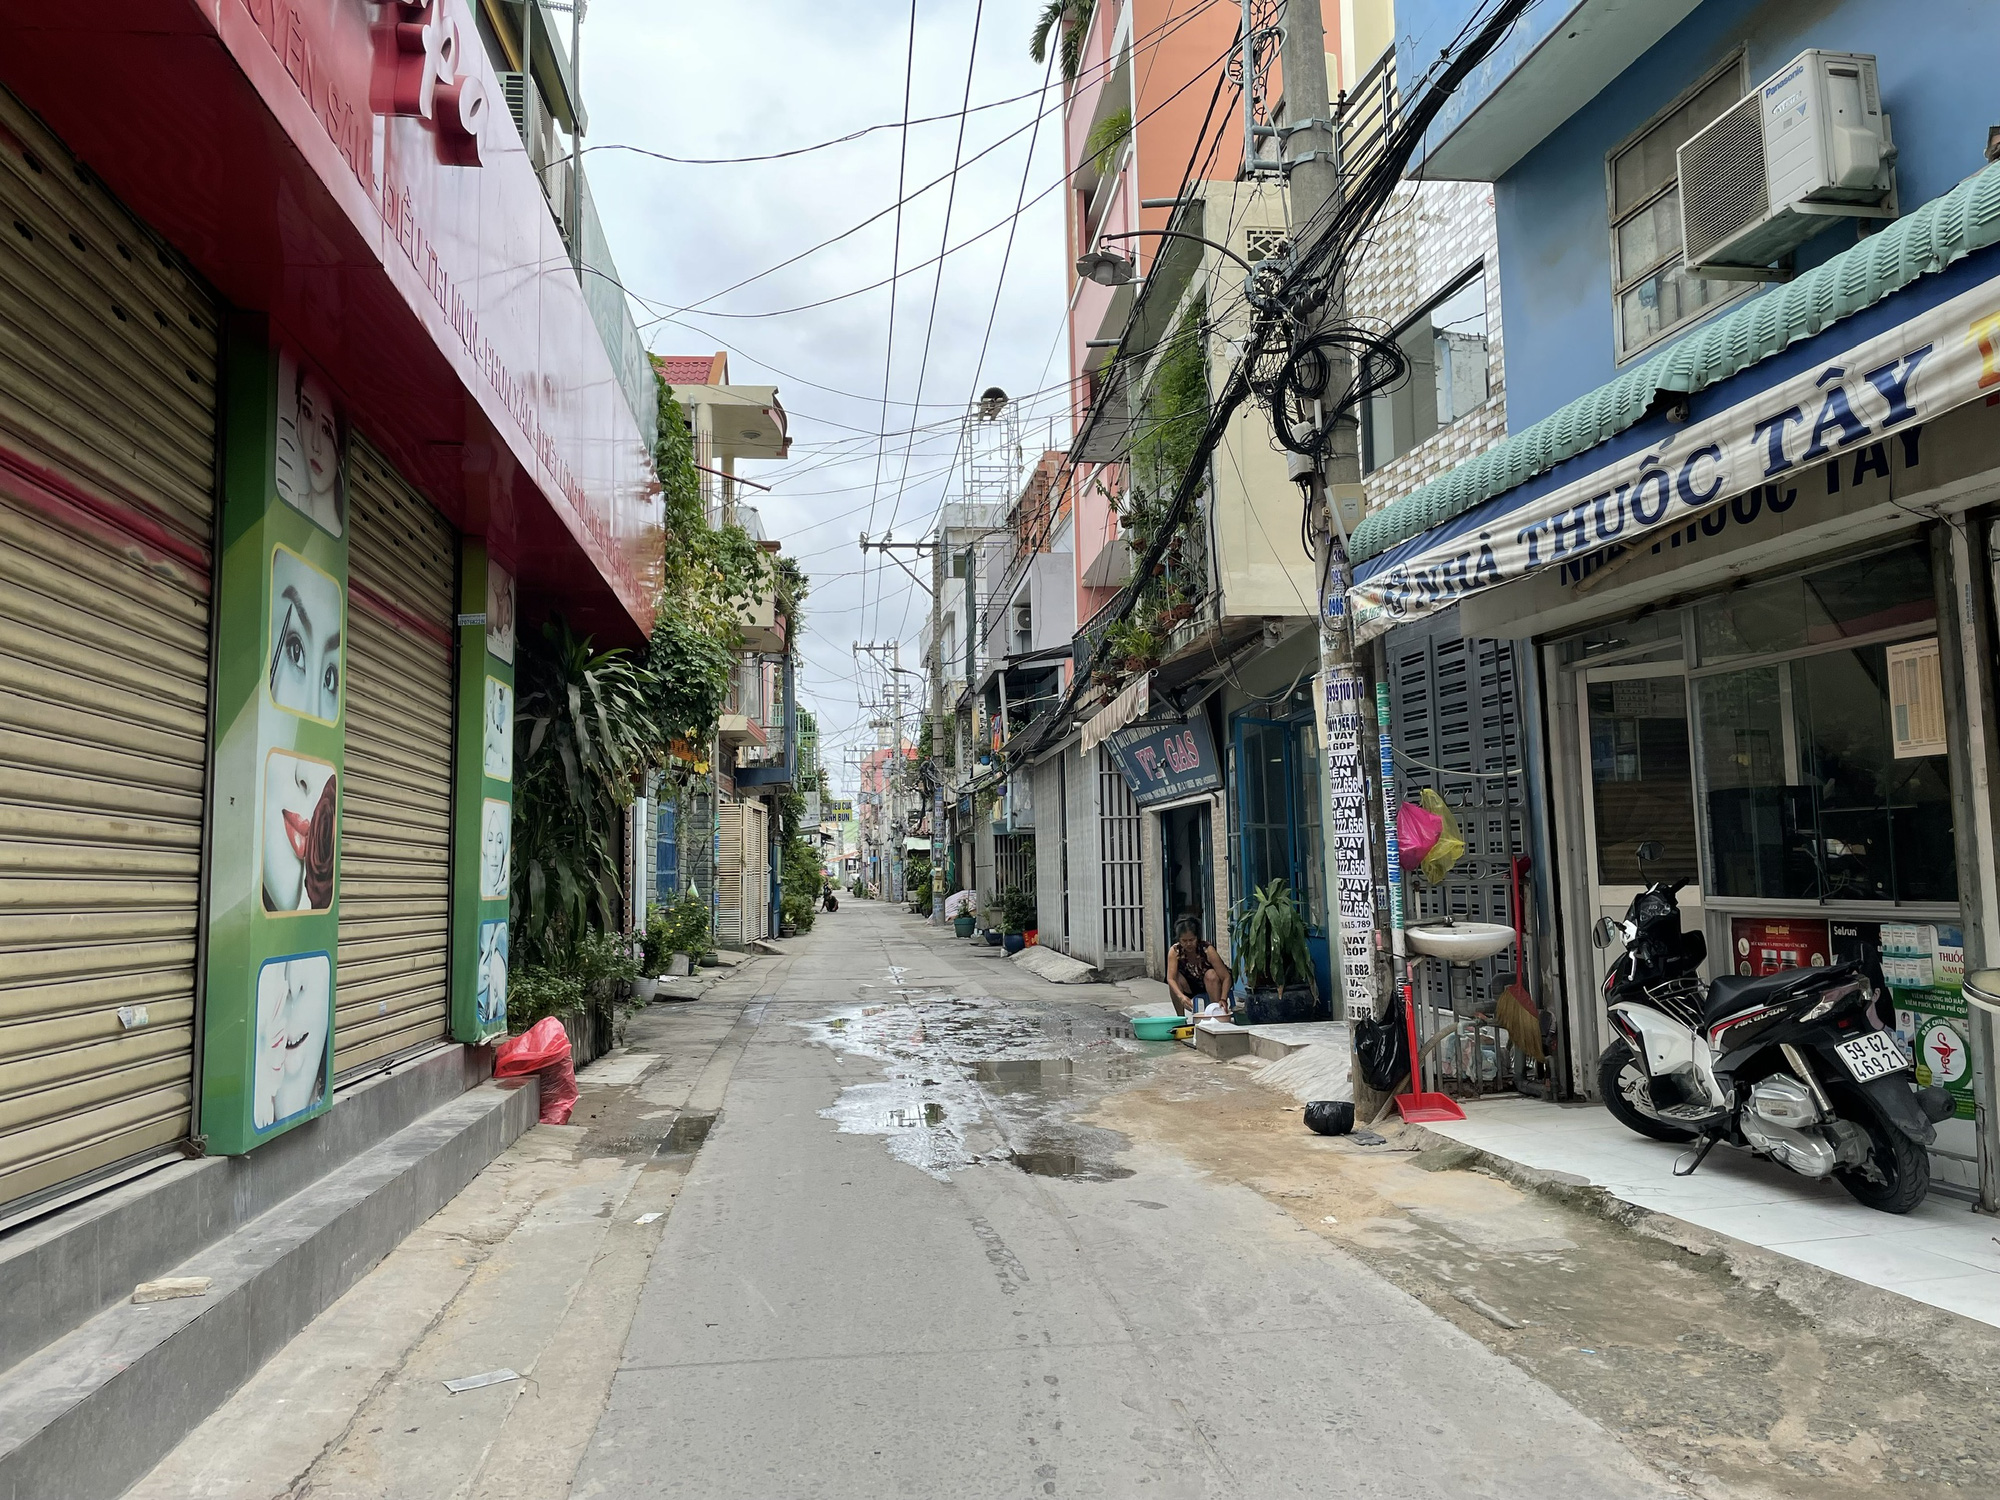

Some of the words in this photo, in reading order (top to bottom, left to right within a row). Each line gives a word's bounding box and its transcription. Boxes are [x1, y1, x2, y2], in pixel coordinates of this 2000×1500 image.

[1765, 65, 1804, 99] Panasonic
[1415, 533, 1504, 608] NHÀ
[1517, 434, 1724, 572] THUỐC
[1752, 344, 1934, 478] TÂY
[1334, 732, 1354, 740] VAY
[1164, 730, 1200, 774] GAS
[1333, 741, 1354, 751] GÓP
[1335, 755, 1356, 767] VAY
[1339, 796, 1361, 807] VAY
[1342, 837, 1363, 848] VAY
[1346, 879, 1368, 891] VAY
[1833, 925, 1857, 937] Selsun
[1347, 936, 1366, 944] VAY
[1346, 946, 1367, 956] GÓP
[1355, 964, 1369, 976] 682
[1942, 965, 1958, 974] NAM
[1754, 1006, 1788, 1022] BLADE
[1844, 1034, 1888, 1060] 59-G2
[1852, 1050, 1905, 1078] 469.21
